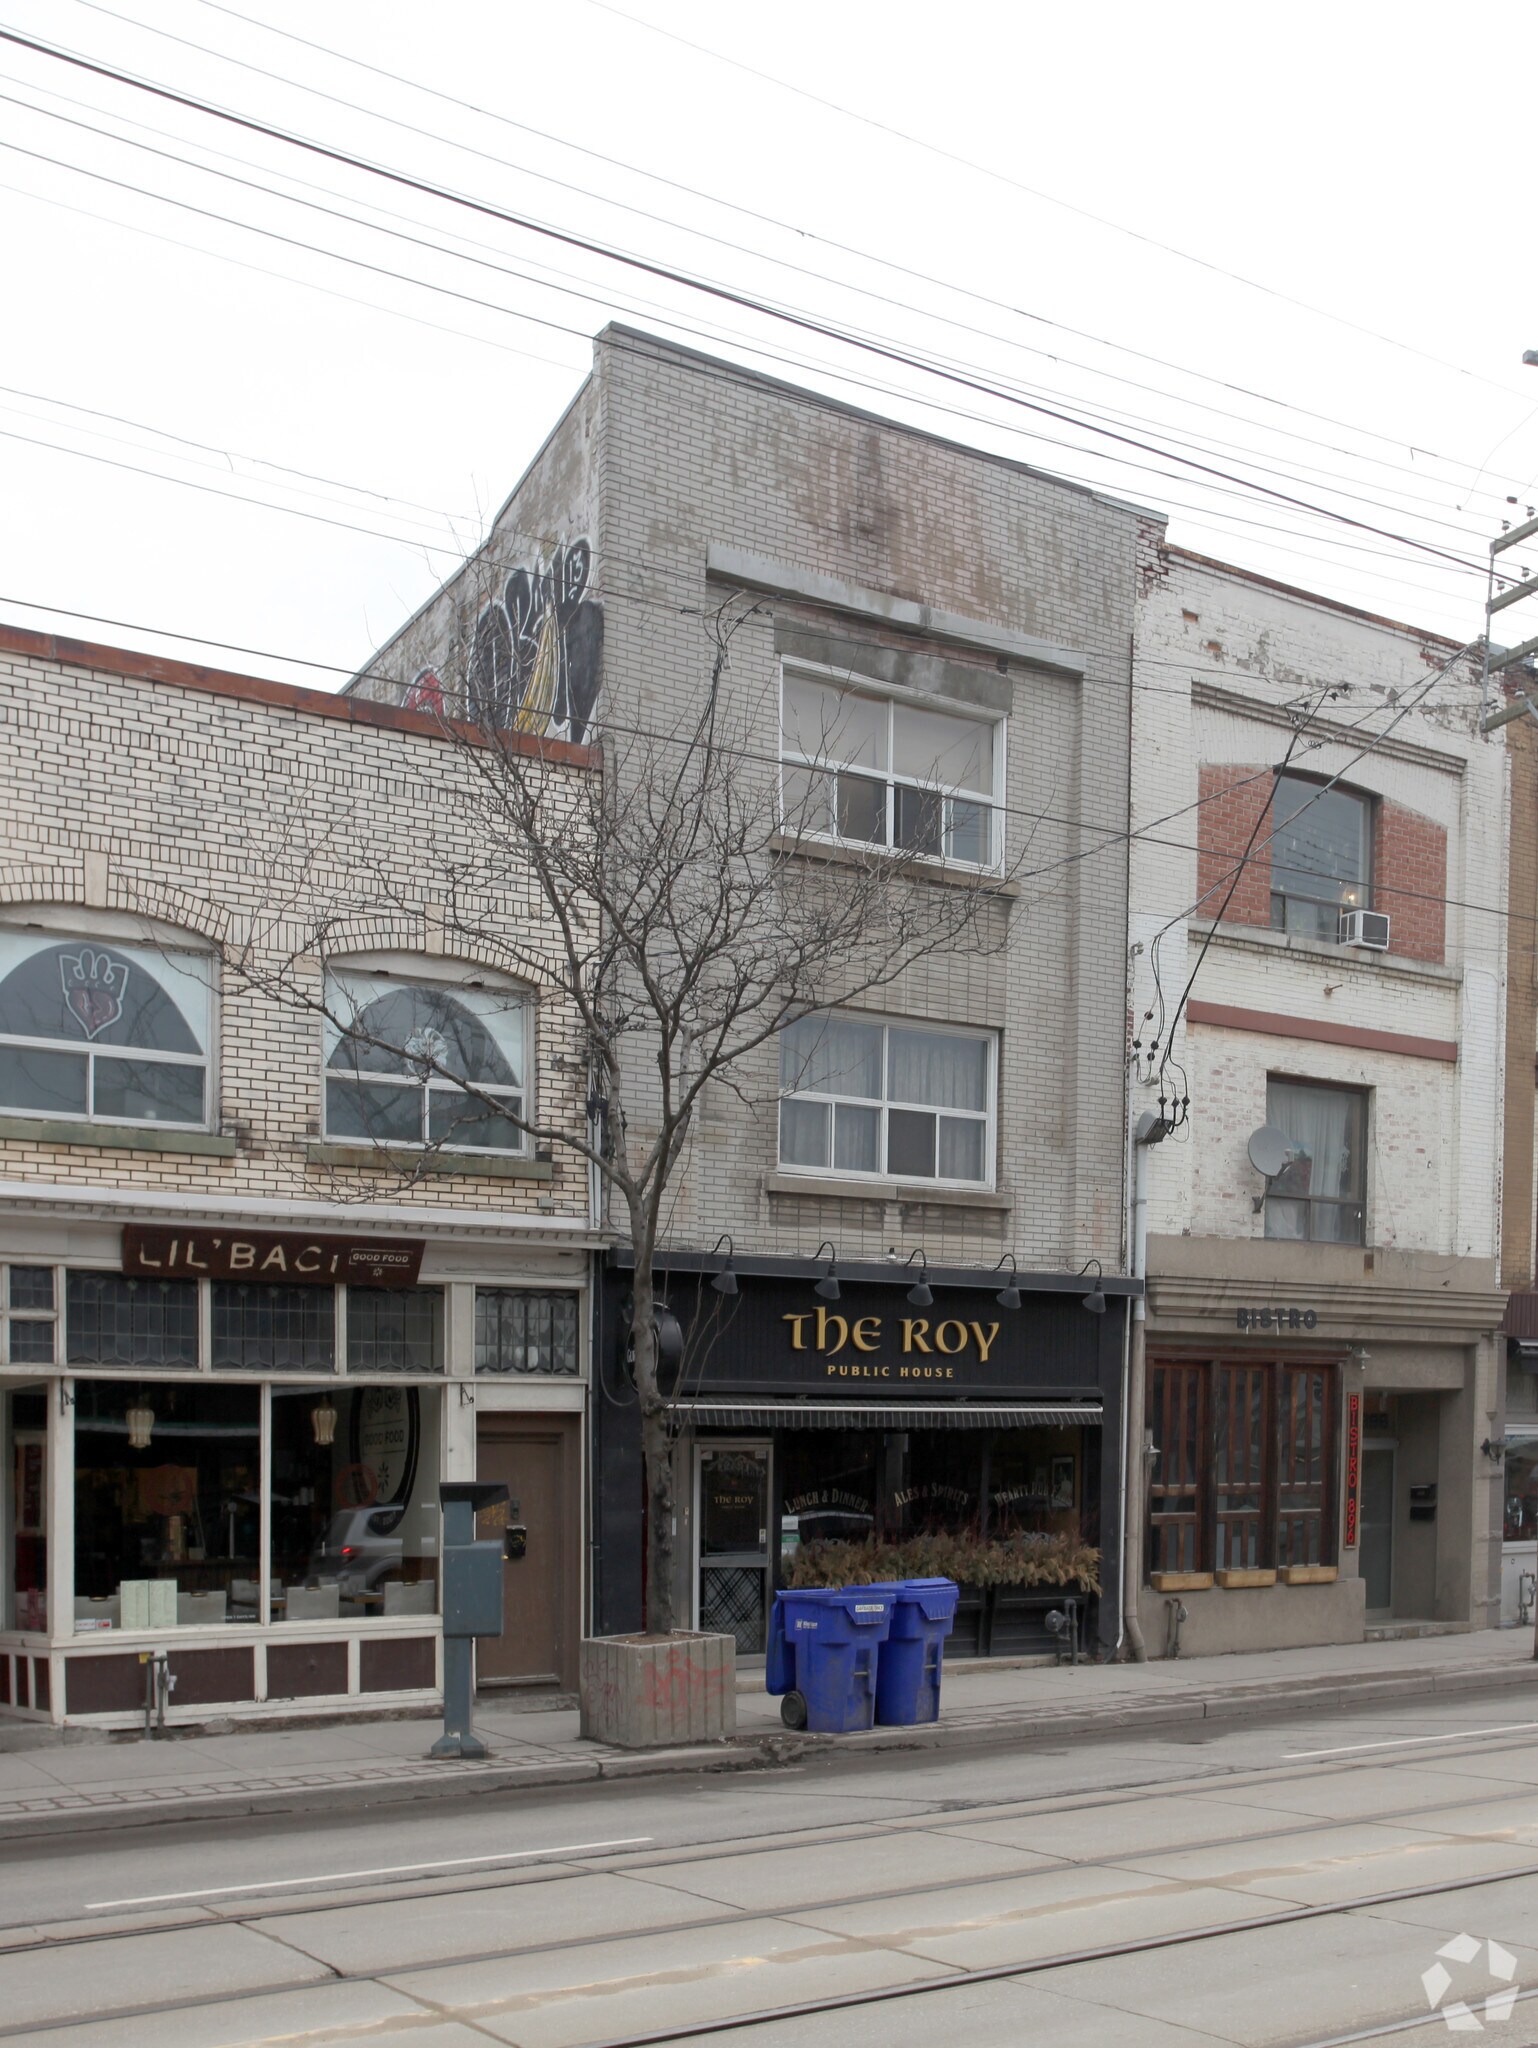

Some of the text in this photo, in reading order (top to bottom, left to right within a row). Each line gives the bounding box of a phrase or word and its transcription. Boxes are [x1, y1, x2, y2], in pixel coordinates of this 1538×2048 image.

[352, 1253, 409, 1263] GOOD FOOD
[1236, 1307, 1317, 1330] BISTRO
[827, 1365, 953, 1378] PUBLIC HOUSE
[385, 1429, 405, 1445] FOOD
[1347, 1396, 1359, 1488] BISTRO
[785, 1488, 869, 1514] LUNCH & DINNER
[894, 1482, 969, 1507] ALES & SPIRITS
[1346, 1498, 1356, 1544] 896
